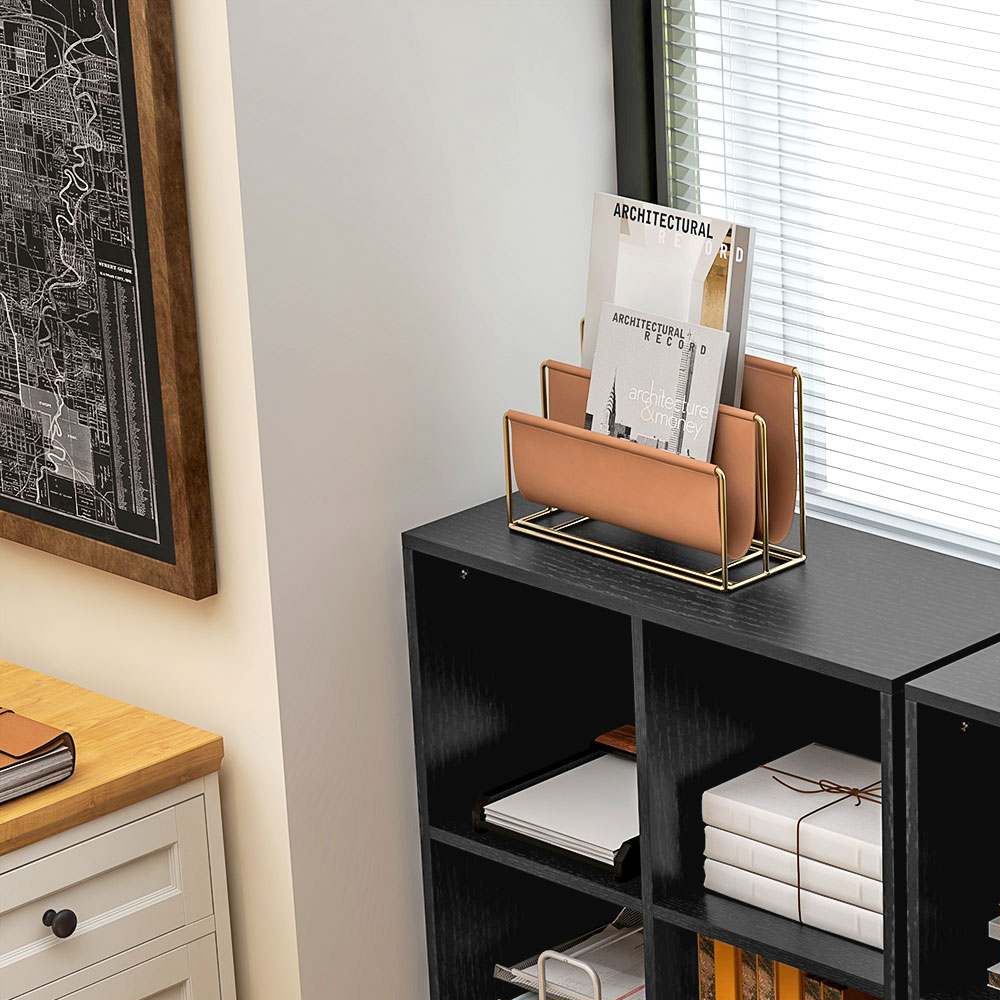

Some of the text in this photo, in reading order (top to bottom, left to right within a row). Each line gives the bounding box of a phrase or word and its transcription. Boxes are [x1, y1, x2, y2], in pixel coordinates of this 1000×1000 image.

[613, 202, 714, 240] ARCHITECTURAL
[657, 230, 745, 263] REORD
[612, 312, 685, 340] ARCHITECTURAL
[644, 331, 707, 356] RECORD
[628, 379, 710, 420] architecture
